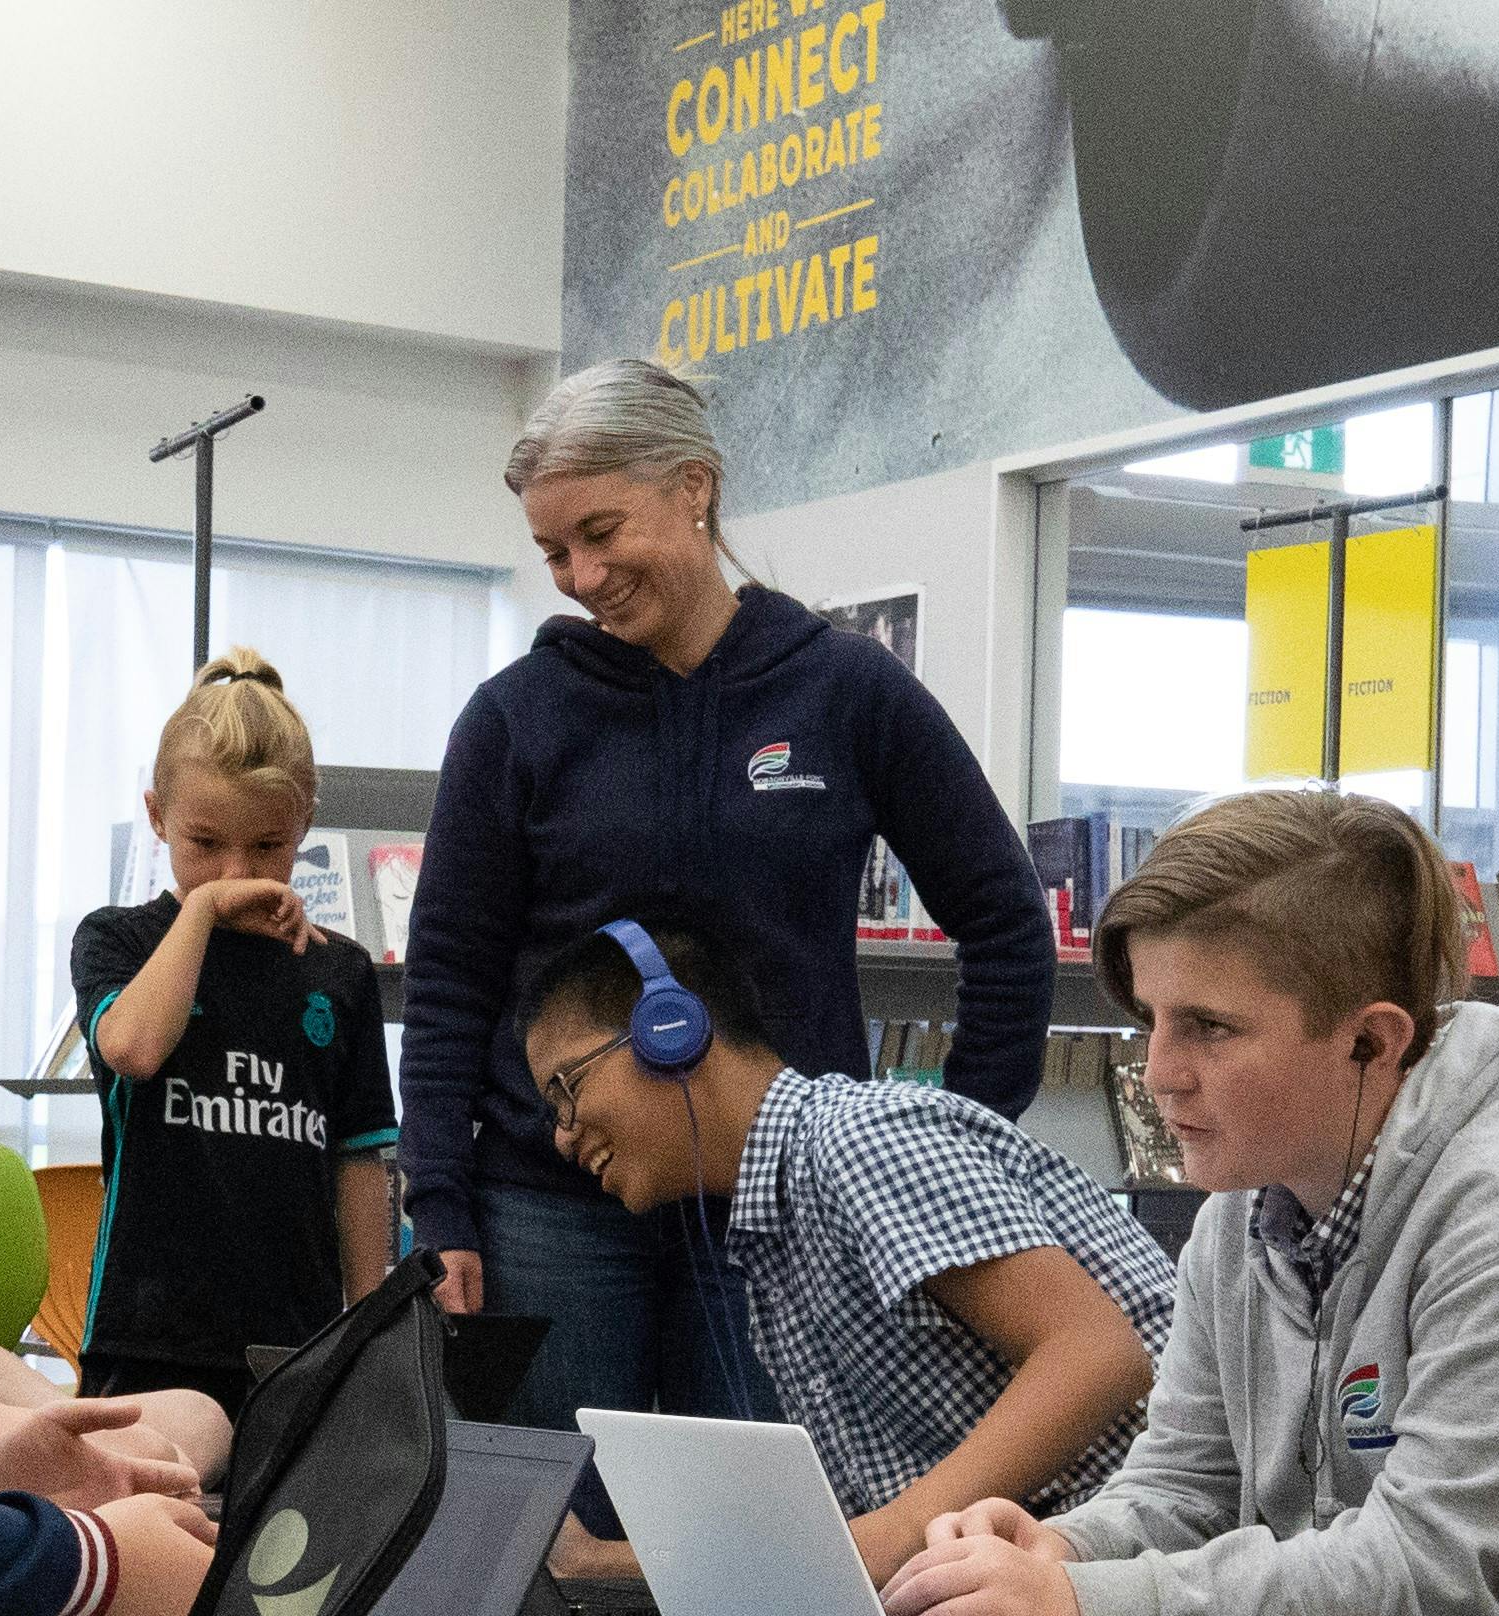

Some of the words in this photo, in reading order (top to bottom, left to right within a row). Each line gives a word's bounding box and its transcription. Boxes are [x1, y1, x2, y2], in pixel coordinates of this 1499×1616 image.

[720, 0, 780, 47] HERE
[666, 1, 886, 157] CONNECT
[663, 104, 883, 229] COLLABORATE
[743, 211, 791, 258] AND
[658, 235, 879, 367] CULTIVATE
[1247, 689, 1291, 706] FICTION
[1348, 678, 1394, 696] FICTION
[226, 1051, 284, 1094] Fly
[164, 1079, 328, 1152] Emirates
